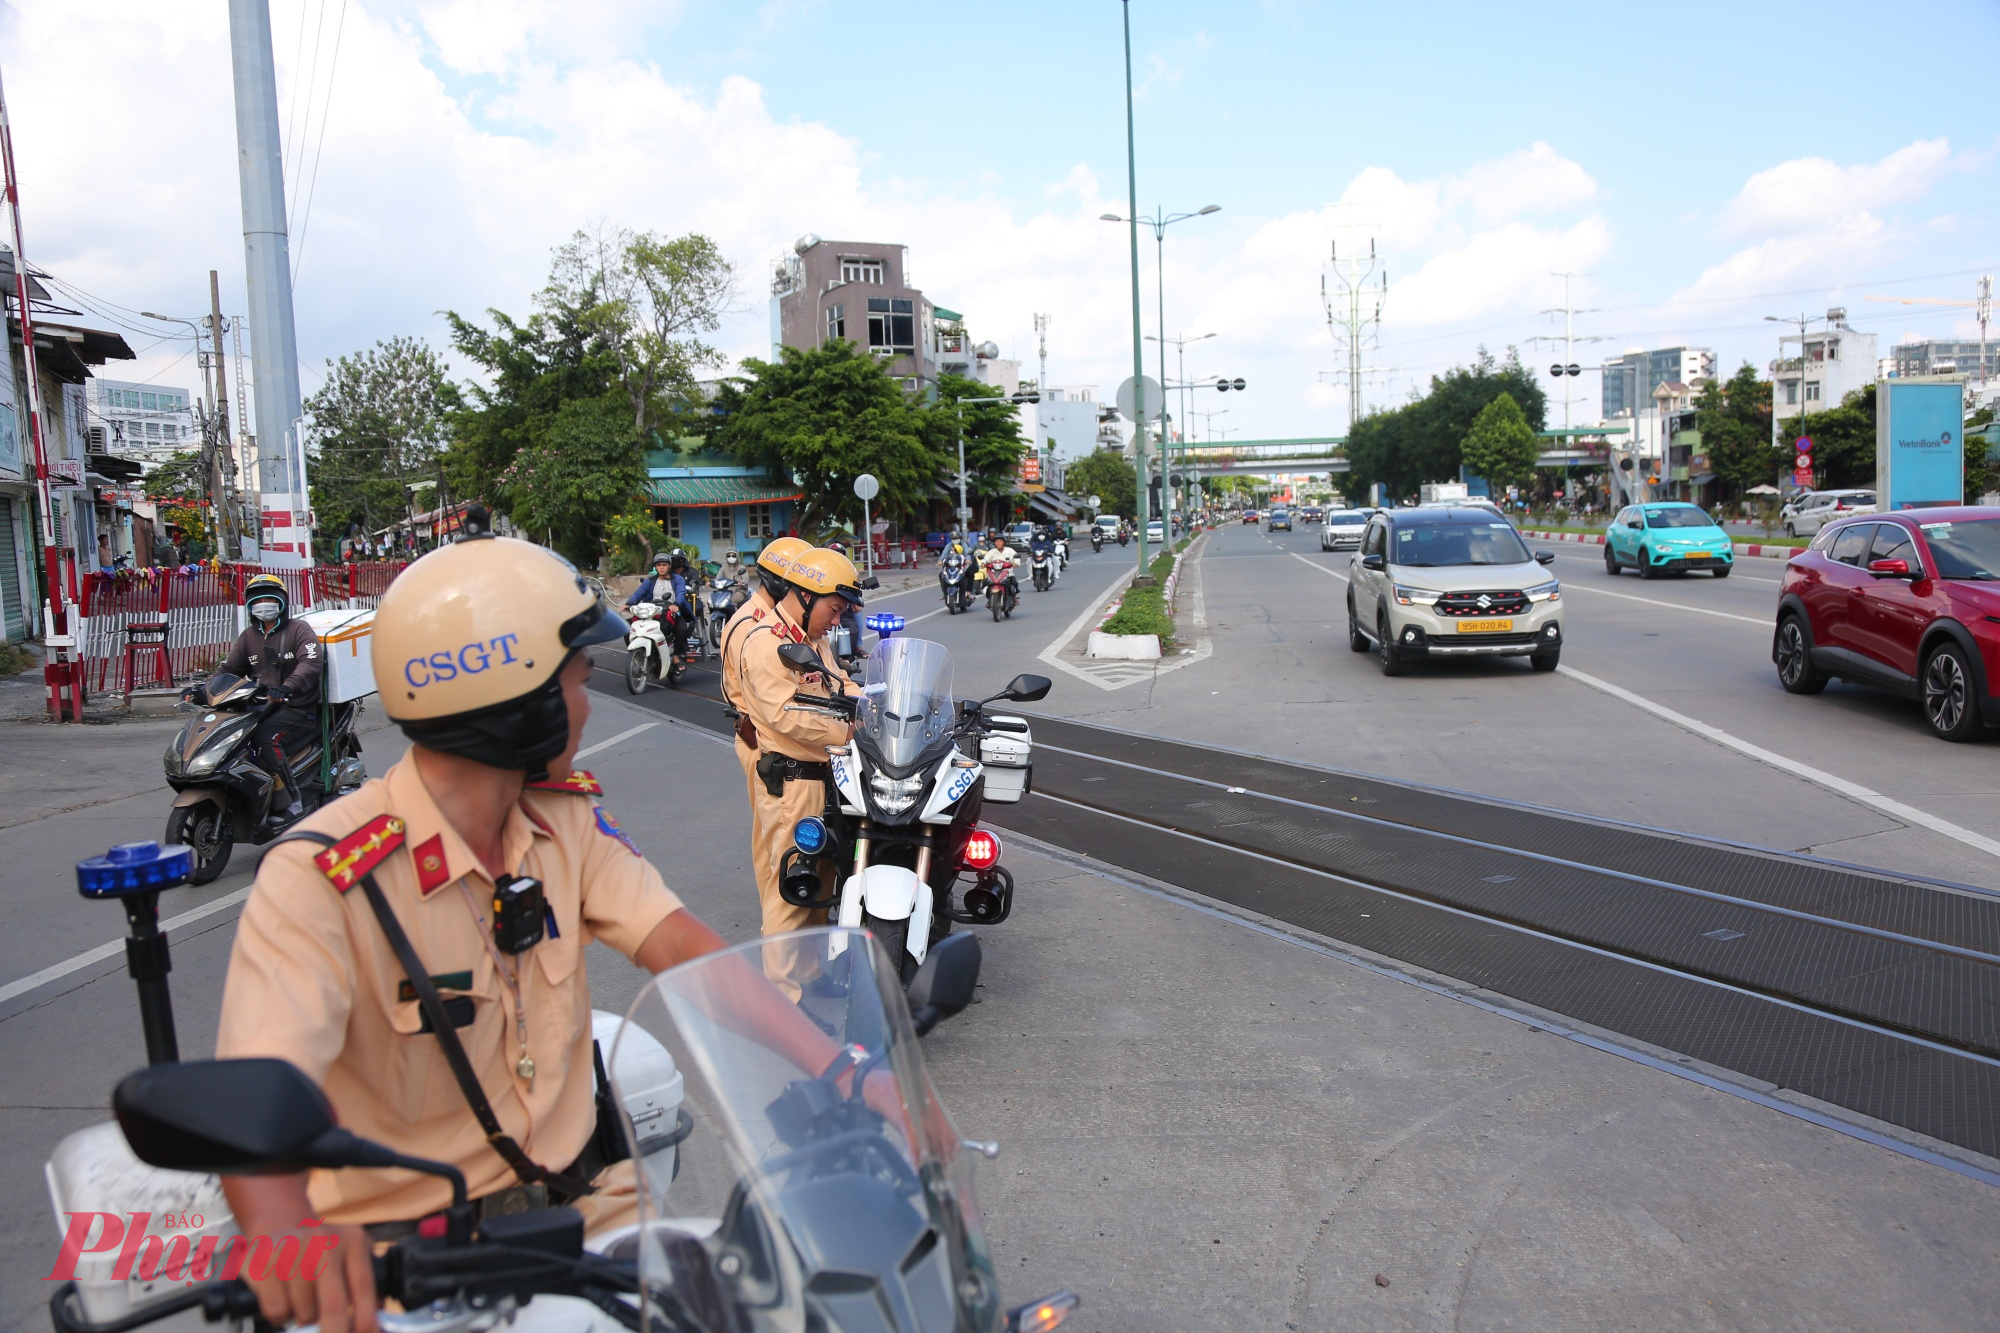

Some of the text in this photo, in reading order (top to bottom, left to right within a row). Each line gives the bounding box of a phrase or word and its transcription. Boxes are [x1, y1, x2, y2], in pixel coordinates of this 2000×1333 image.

[1898, 438, 1941, 448] VietinBank
[791, 563, 826, 583] CSGT
[1462, 620, 1508, 631] 95H-020.84
[404, 632, 519, 688] CSGT
